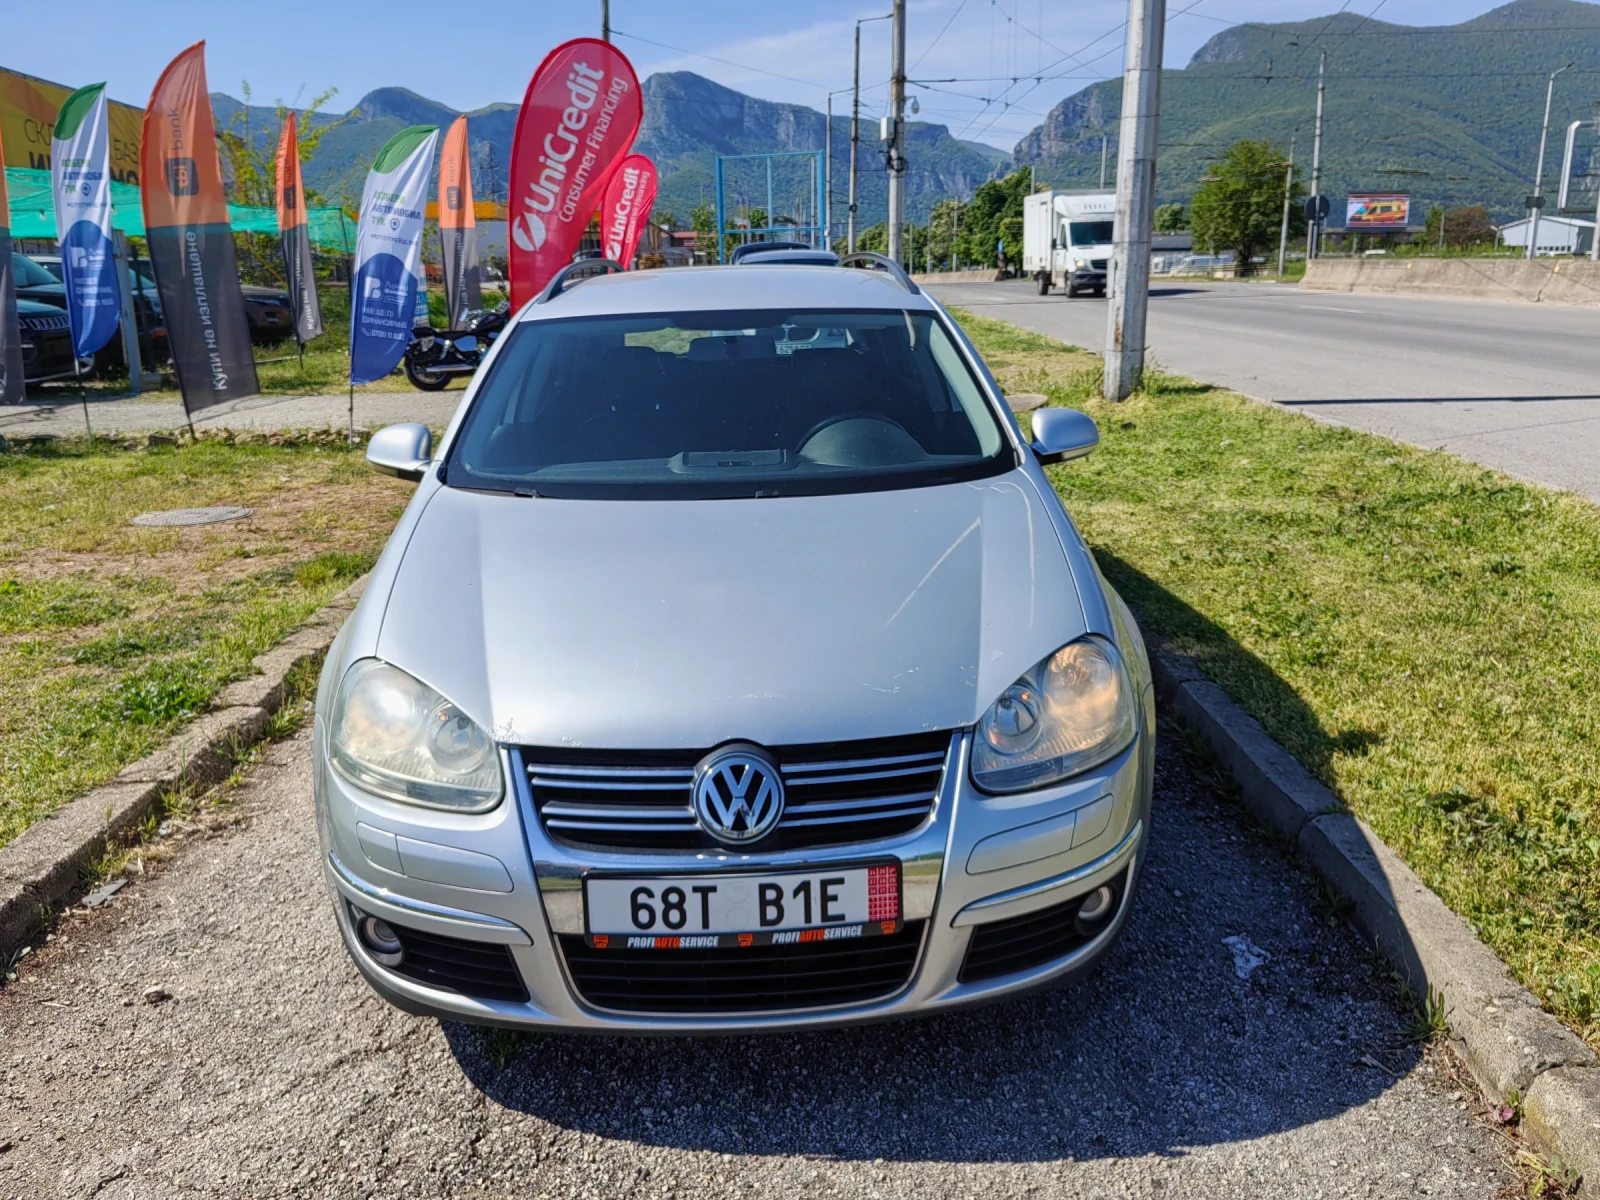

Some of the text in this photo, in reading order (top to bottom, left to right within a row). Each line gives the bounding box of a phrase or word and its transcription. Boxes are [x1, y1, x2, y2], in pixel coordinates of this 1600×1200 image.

[113, 138, 139, 165] БАЗ
[167, 108, 184, 151] bank
[524, 61, 605, 214] UniCredit
[558, 77, 629, 223] Consumer Financing
[609, 167, 640, 241] UniCredit
[186, 231, 228, 391] Купи на изплащане
[630, 885, 718, 930] 68T
[758, 877, 846, 928] B1E
[627, 936, 719, 949] PROFIAUTOSERVICE
[772, 925, 863, 945] PROFIAUTOSERVICE
